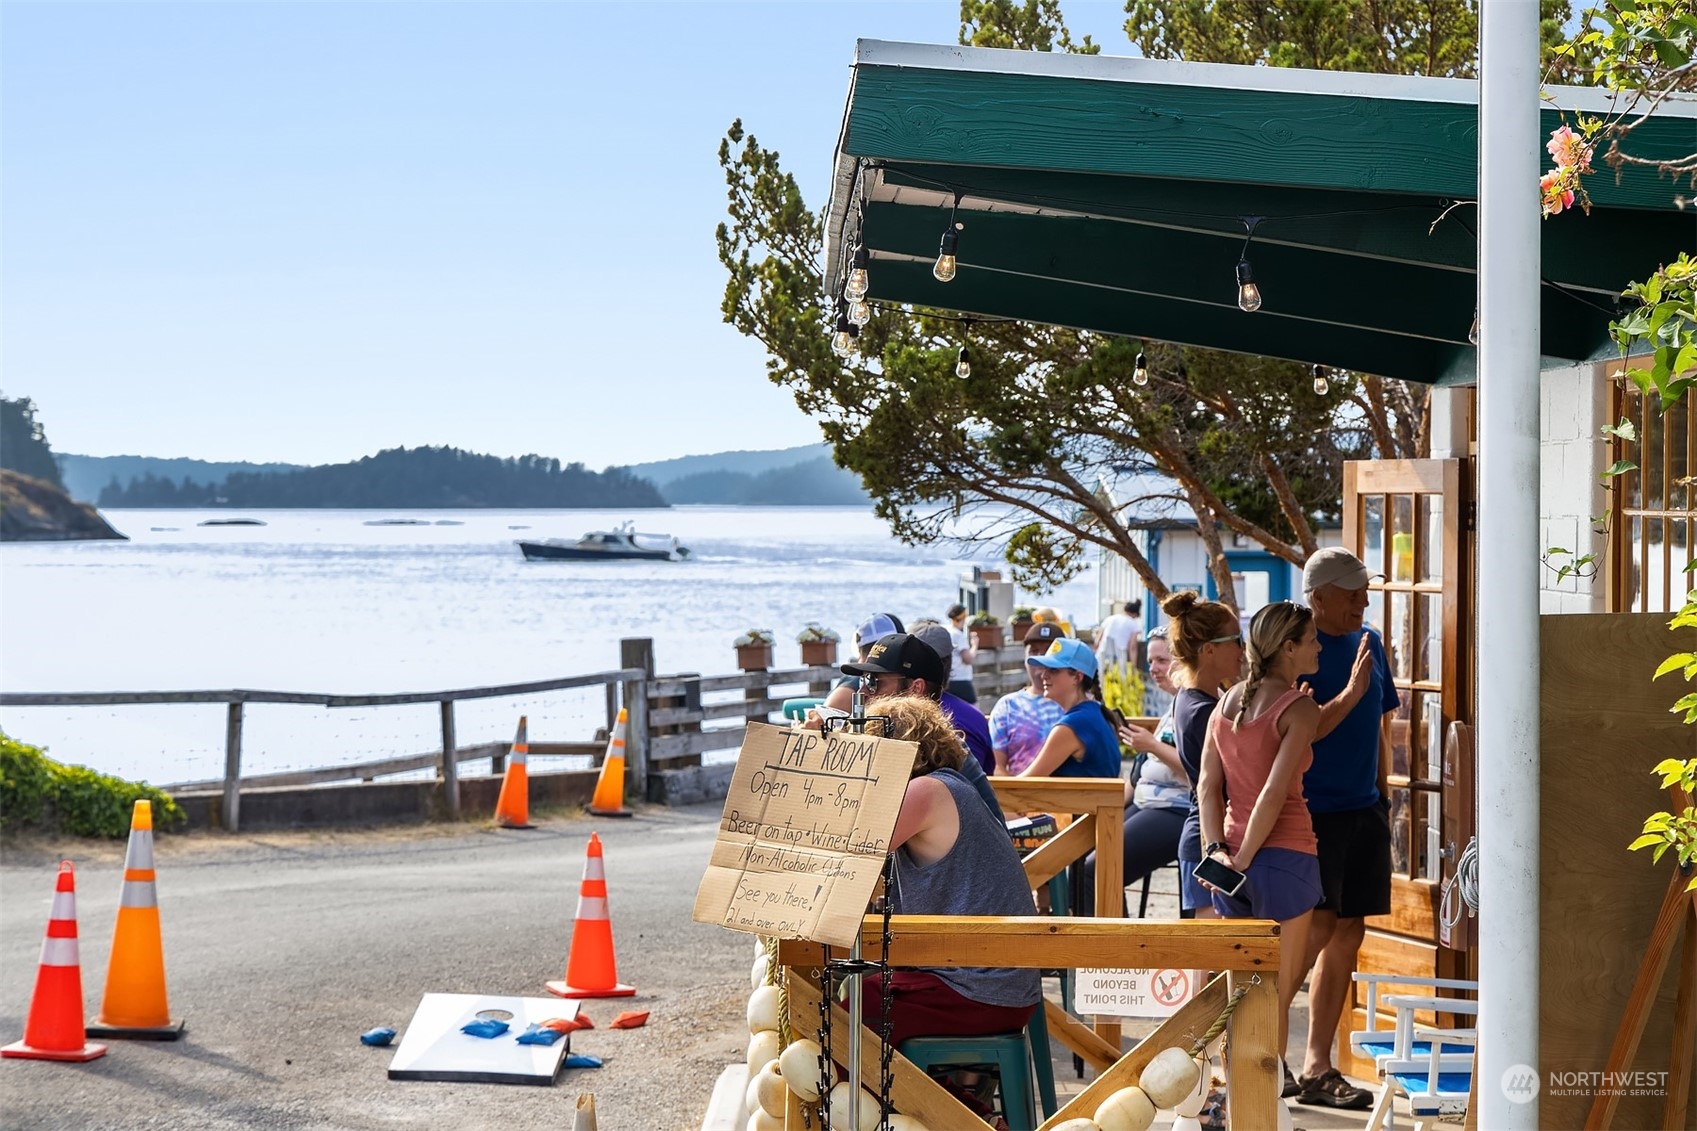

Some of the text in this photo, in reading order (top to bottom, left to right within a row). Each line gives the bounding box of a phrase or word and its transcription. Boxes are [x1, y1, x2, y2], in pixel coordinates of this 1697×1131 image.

[779, 731, 874, 777] TAP ROOM
[750, 771, 789, 801] Open
[728, 810, 762, 836] Beer
[765, 825, 779, 840] on
[811, 822, 843, 850] Wine
[846, 827, 884, 856] Cider
[739, 842, 817, 873] Non-Alcoholic
[736, 879, 761, 903] See
[762, 890, 782, 908] you
[727, 907, 806, 933] 21 and over ONLY
